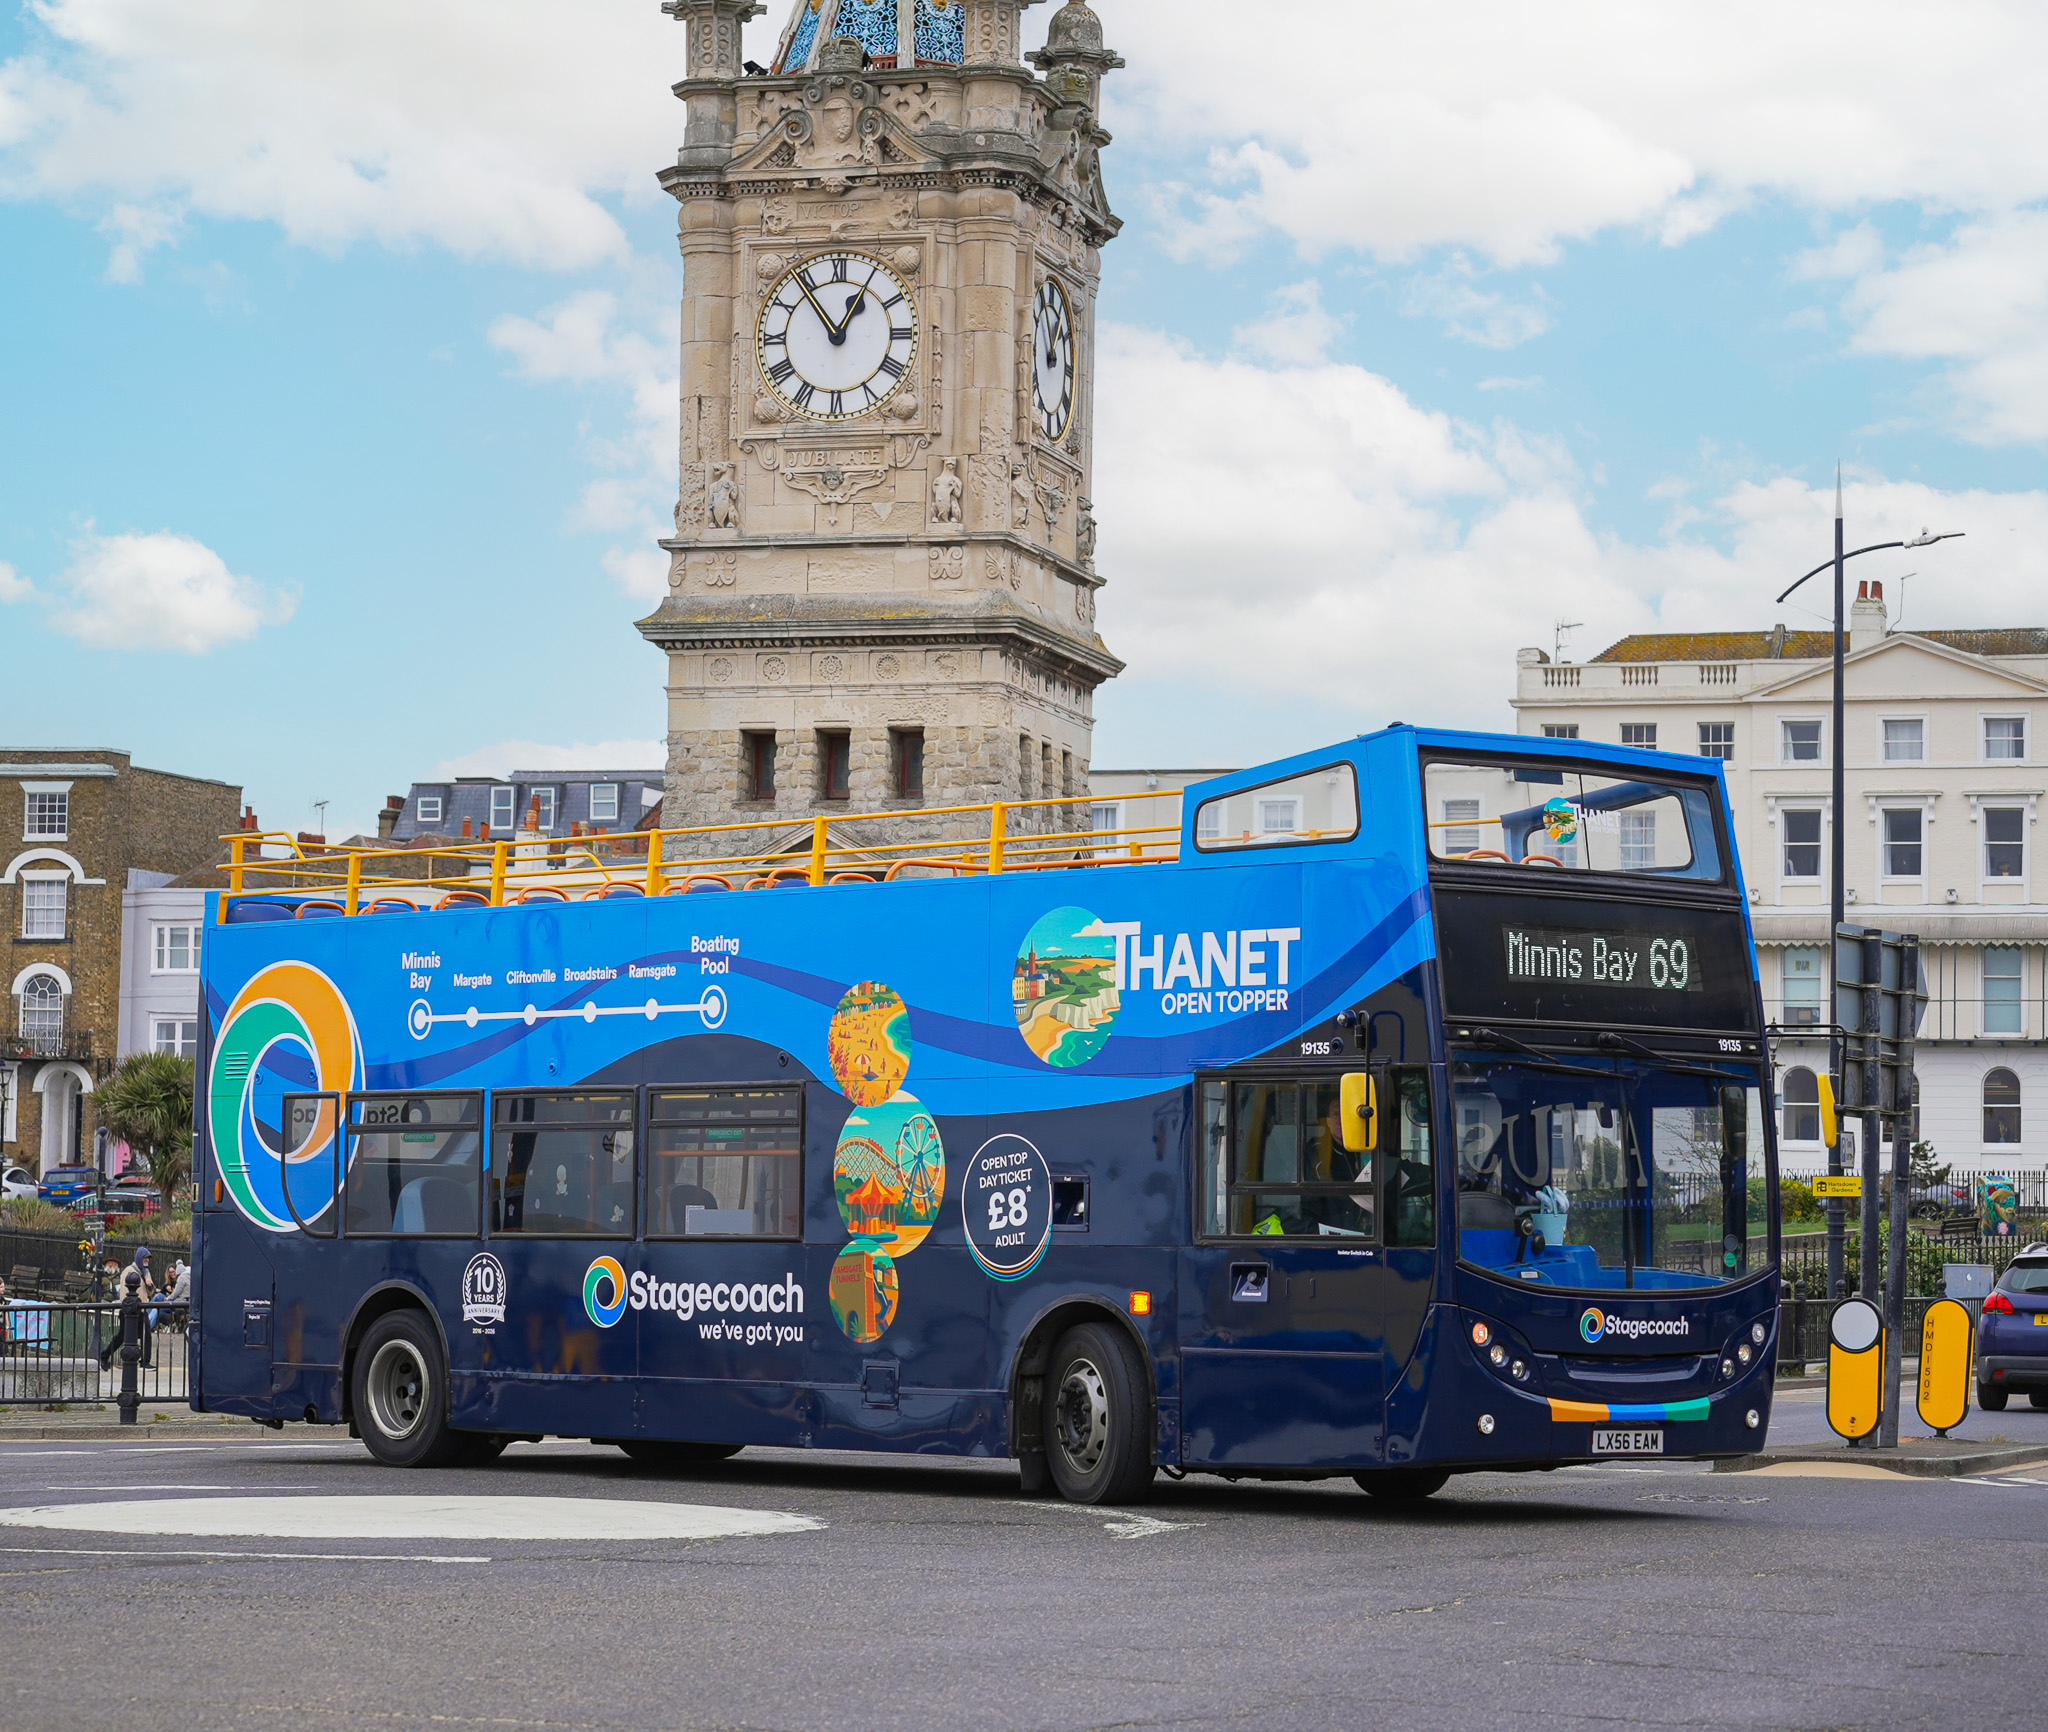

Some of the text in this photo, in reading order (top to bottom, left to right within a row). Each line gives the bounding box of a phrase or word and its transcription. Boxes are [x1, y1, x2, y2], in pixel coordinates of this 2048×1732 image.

[788, 450, 881, 467] JUBILATE
[1569, 803, 1622, 828] THANET
[691, 934, 740, 955] Boating
[402, 951, 441, 969] Minnis
[701, 956, 729, 975] Pool
[1100, 921, 1301, 991] THANET
[1508, 931, 1688, 989] Minnis Bay 69
[453, 973, 492, 989] Margate
[506, 969, 556, 985] Cliftonville
[563, 966, 618, 982] Broadstairs
[628, 963, 676, 981] Ramsgate
[410, 972, 431, 992] Bay
[1161, 989, 1289, 1015] OPEN TOPPER
[1301, 1042, 1330, 1055] 19135
[1718, 1038, 1741, 1052] 19135
[981, 1151, 1028, 1171] OPEN TOP
[979, 1168, 1032, 1189] DAY TICKET
[995, 1232, 1025, 1248] ADULT
[474, 1266, 494, 1293] 10
[473, 1294, 495, 1303] YEARS
[629, 1270, 804, 1321] Stagecoach
[699, 1319, 804, 1346] we've got you
[1605, 1315, 1689, 1339] Stagecoach
[1597, 1433, 1658, 1450] LX56 EAM
